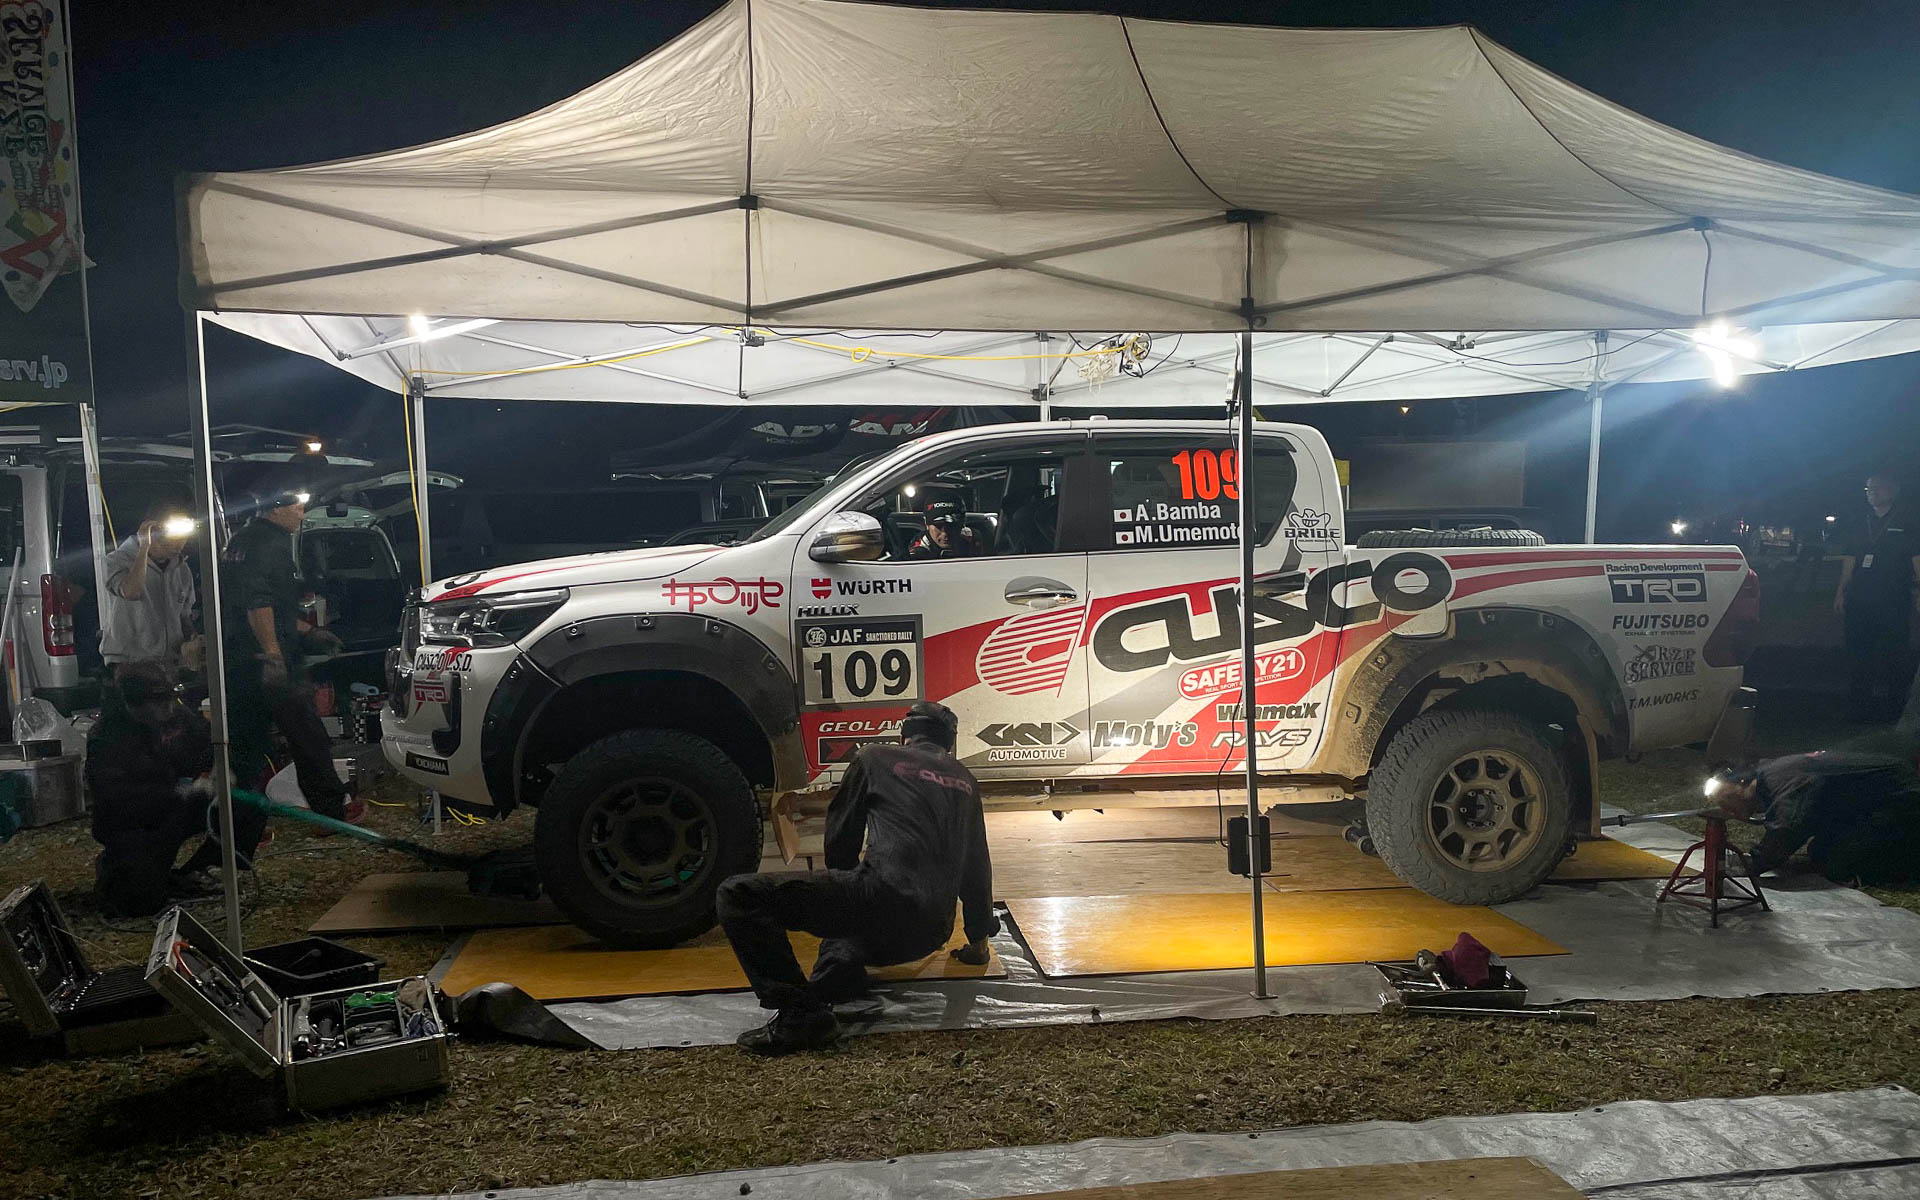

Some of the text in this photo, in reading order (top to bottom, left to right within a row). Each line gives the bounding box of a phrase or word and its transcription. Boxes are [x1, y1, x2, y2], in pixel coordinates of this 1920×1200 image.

[1172, 450, 1240, 500] 109
[1283, 527, 1340, 539] BRIDE
[1606, 562, 1704, 573] Racing Development
[1613, 578, 1702, 604] TRD
[1612, 614, 1710, 629] FUJITSUBO
[829, 628, 863, 644] JAF
[865, 632, 897, 642] SANCTIONED
[897, 631, 913, 641] RALLY
[813, 648, 912, 699] 109
[1182, 651, 1297, 693] SAFEY21
[1628, 689, 1700, 710] T.M.WORKS
[1093, 720, 1198, 749] Moty's
[988, 748, 1067, 761] AUTOMOTIVE
